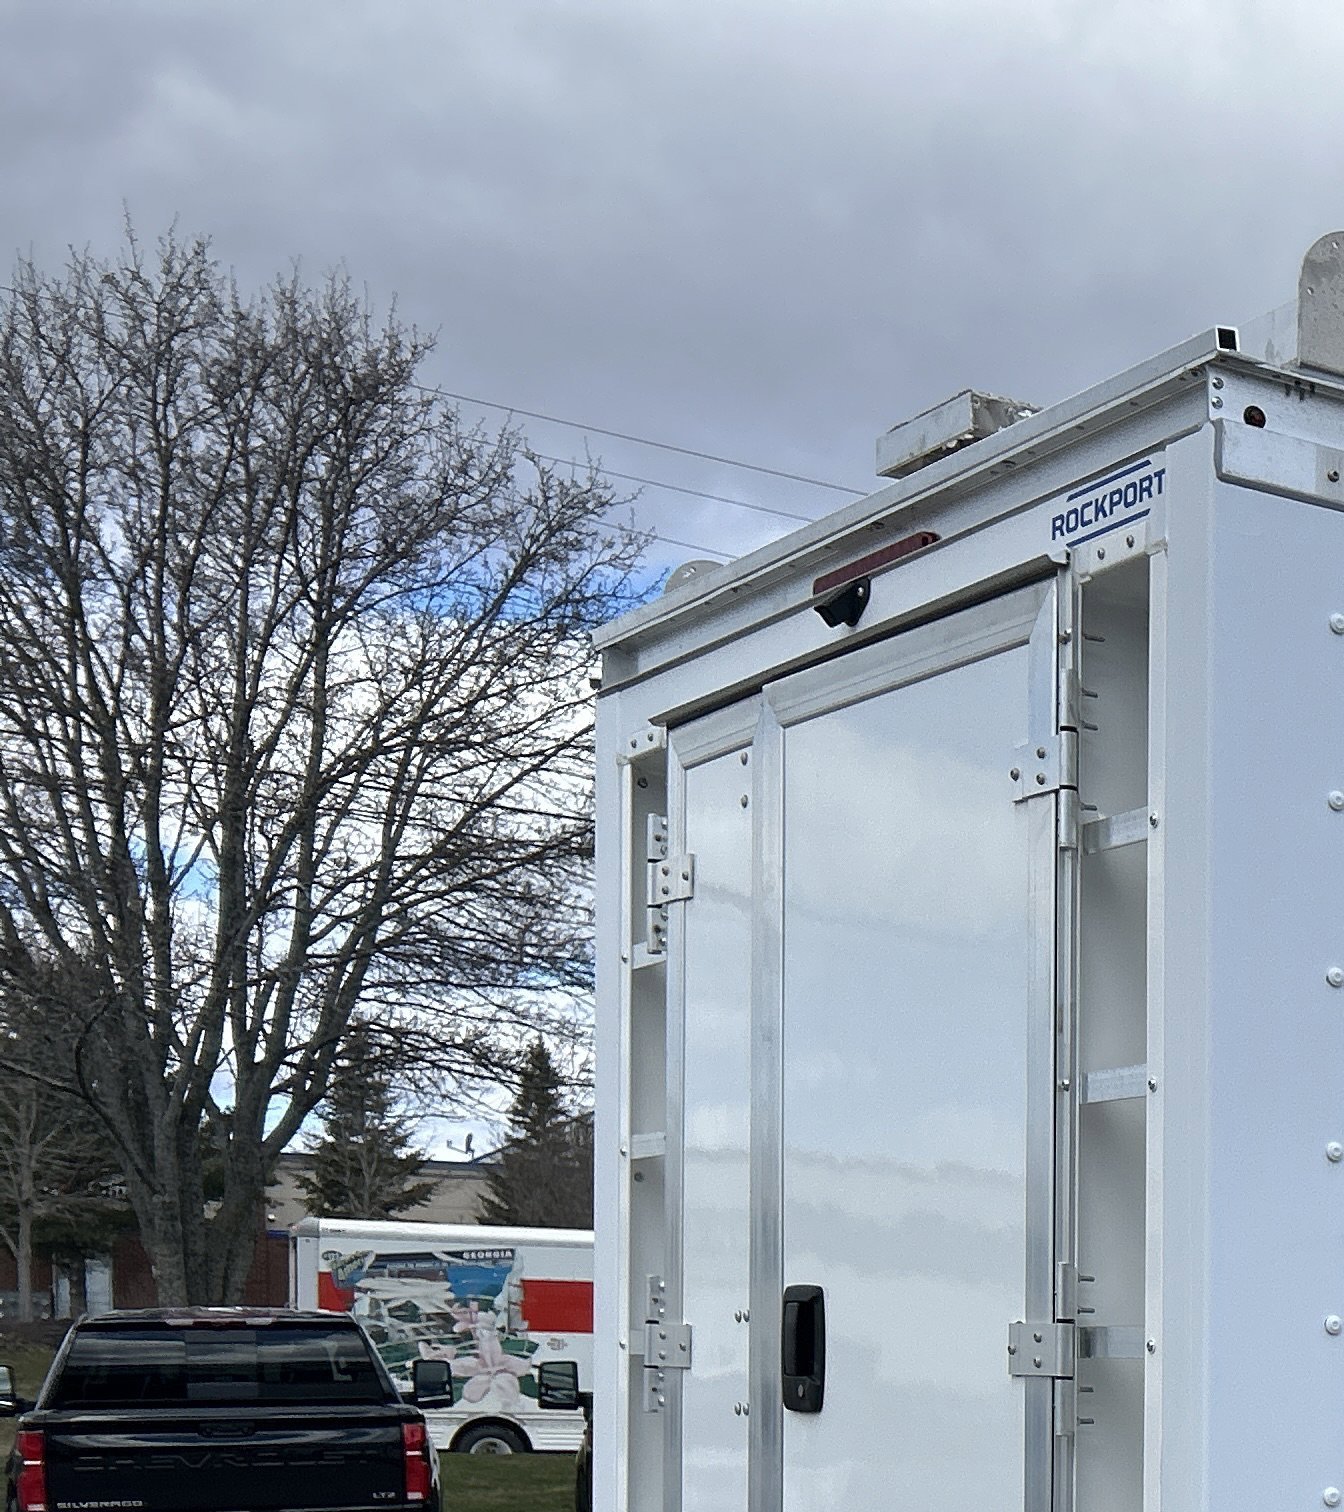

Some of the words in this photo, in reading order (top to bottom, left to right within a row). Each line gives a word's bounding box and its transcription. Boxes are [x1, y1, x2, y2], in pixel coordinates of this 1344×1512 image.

[1051, 468, 1166, 541] ROCKPORT
[462, 1249, 513, 1260] GEORGIA
[56, 1500, 143, 1509] SILVERADO
